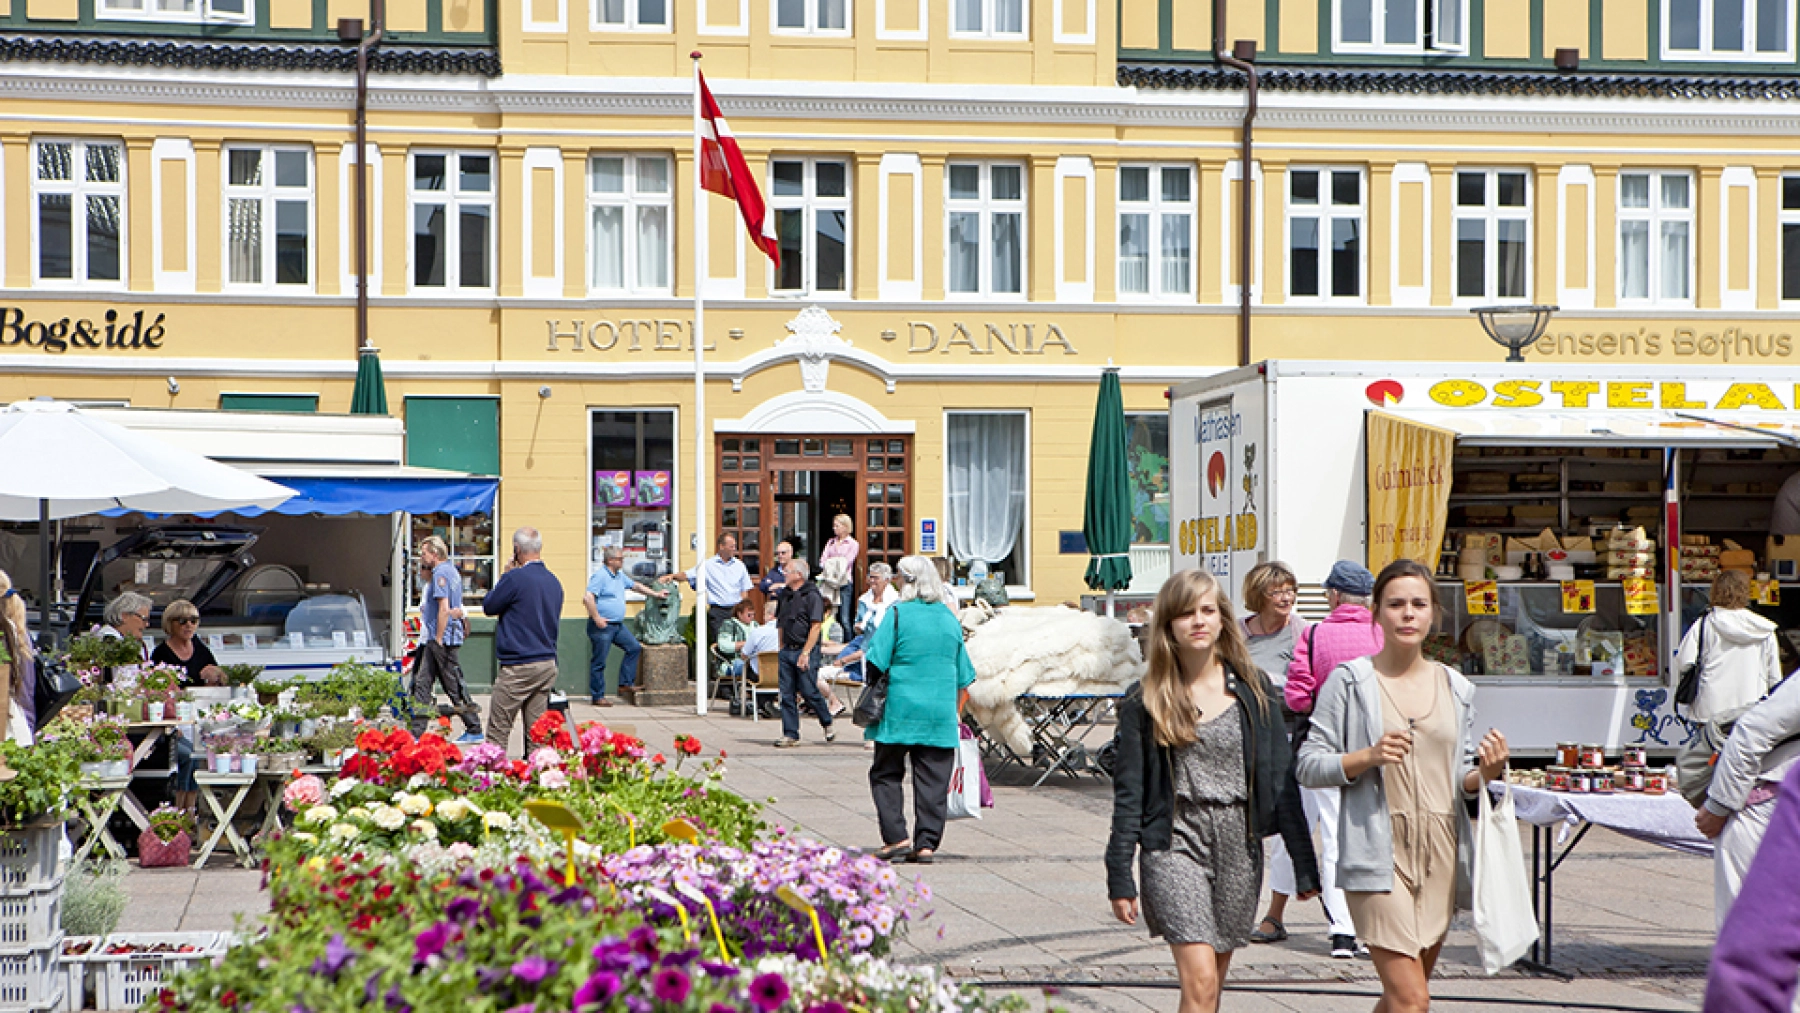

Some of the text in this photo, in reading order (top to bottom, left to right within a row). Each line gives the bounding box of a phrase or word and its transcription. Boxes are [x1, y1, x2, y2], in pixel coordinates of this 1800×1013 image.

[545, 319, 1079, 355] HOTEL DANIA
[1521, 326, 1793, 363] ensen's Bøfhus
[1428, 379, 1800, 411] OSTELA
[1178, 511, 1258, 556] OSTELAND
